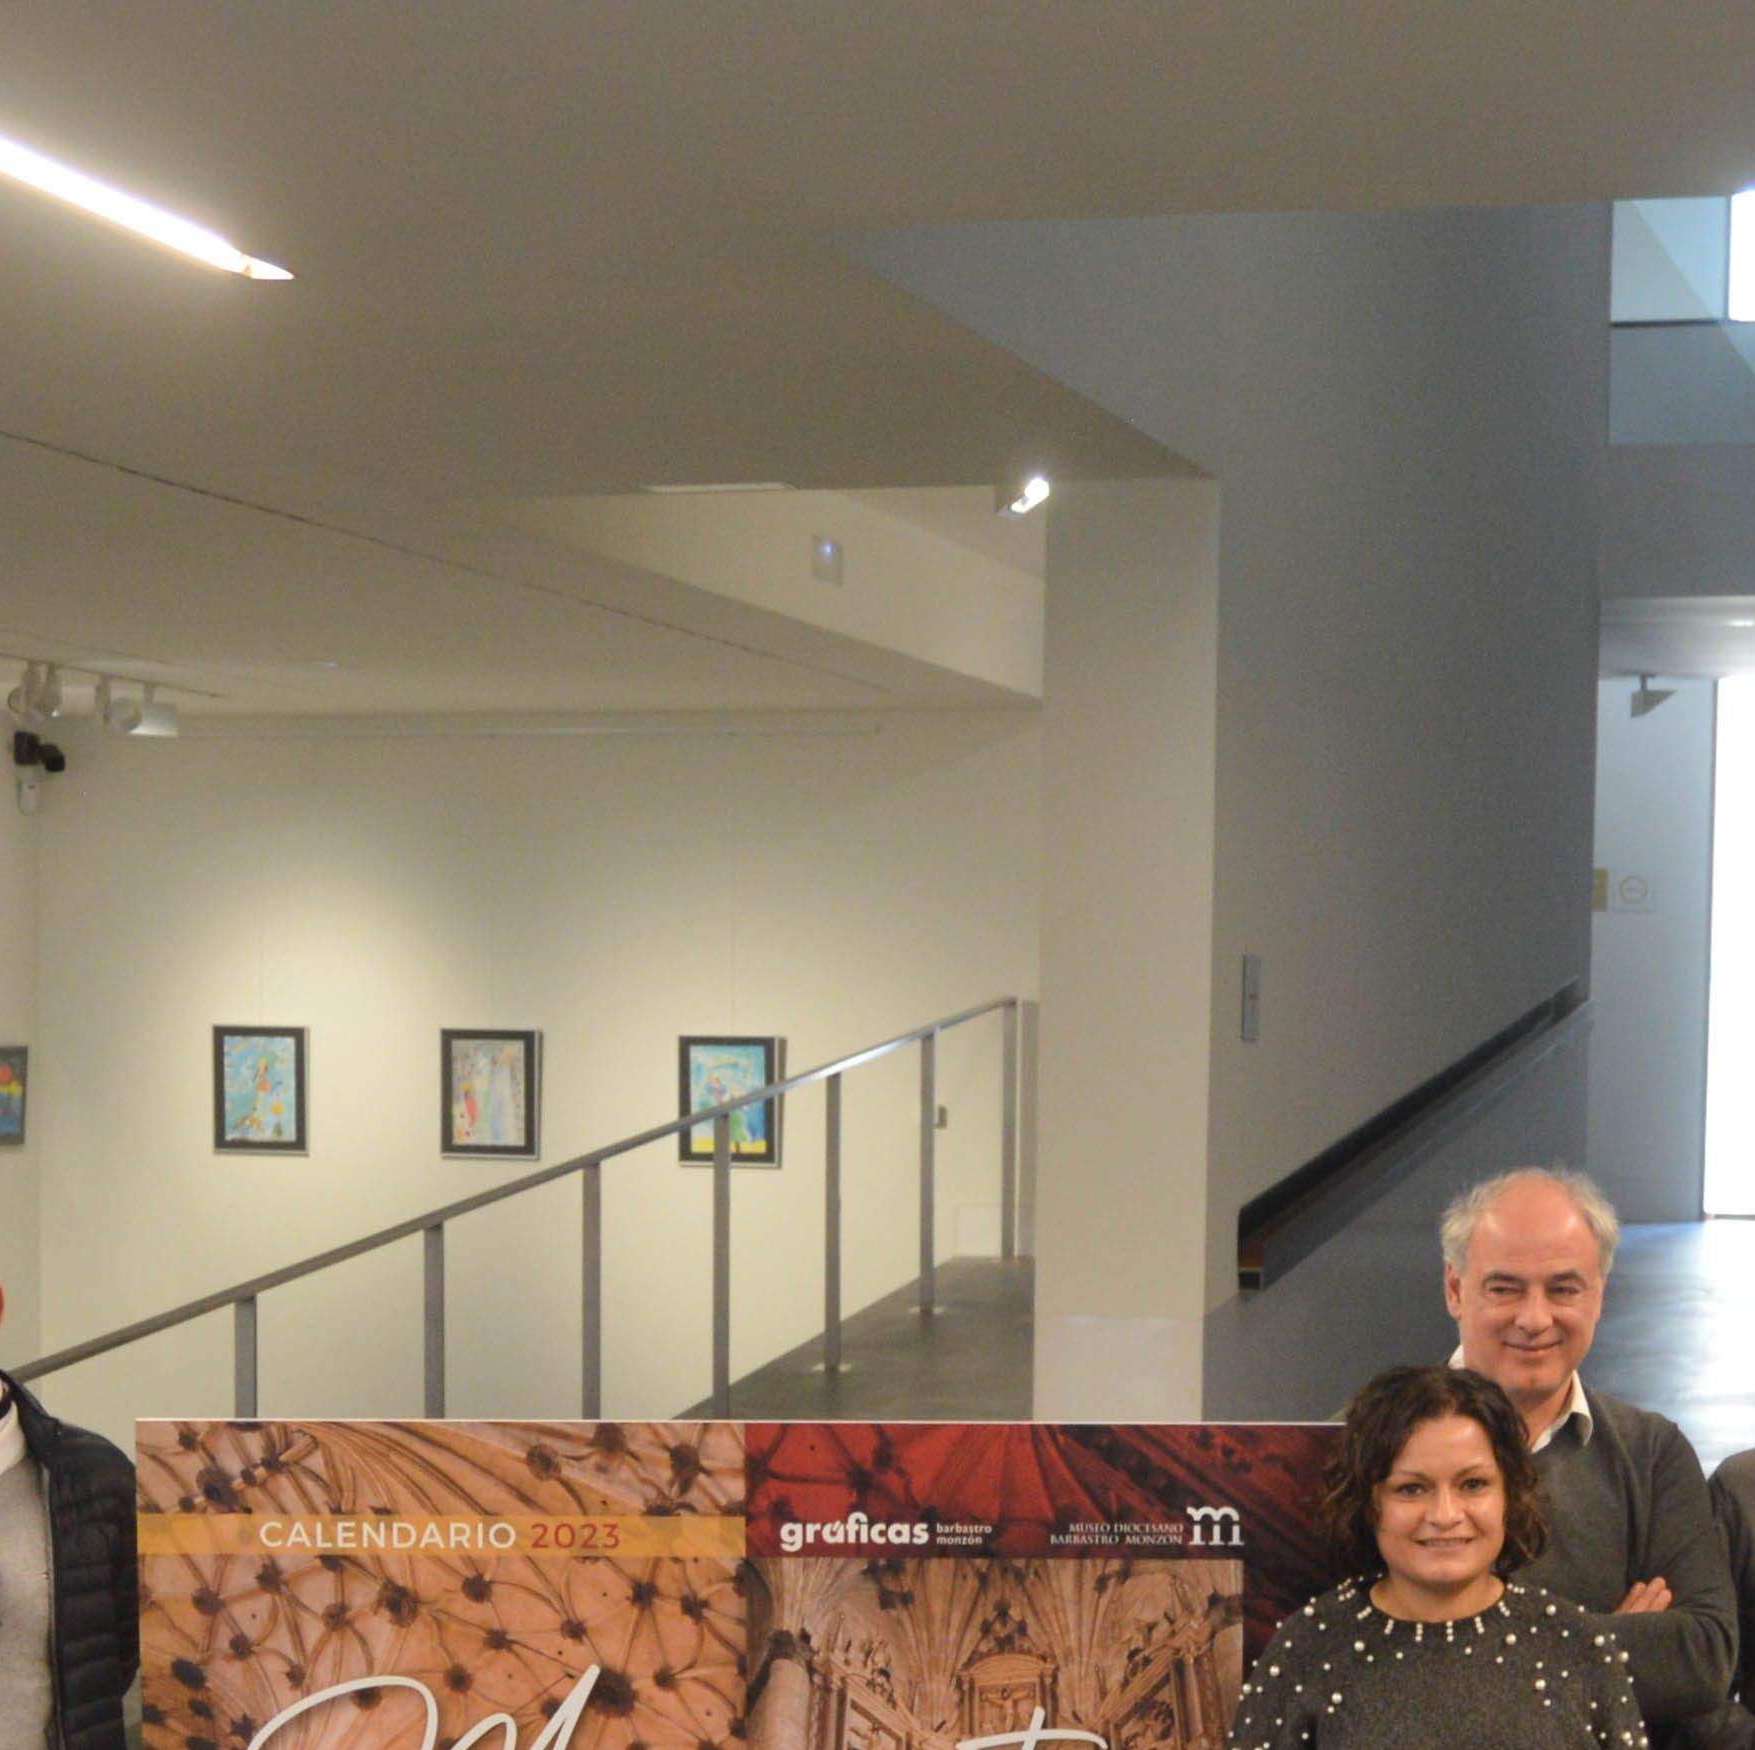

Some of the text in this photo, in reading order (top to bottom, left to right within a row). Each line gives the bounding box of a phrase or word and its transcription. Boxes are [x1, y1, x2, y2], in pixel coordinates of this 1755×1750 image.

[780, 1511, 929, 1552] gráficas
[936, 1522, 992, 1534] barbastro
[1068, 1523, 1184, 1534] MUSEO DIOCESANO
[259, 1521, 620, 1549] CALENDARIO 2023
[1050, 1534, 1119, 1545] BARBASTRO
